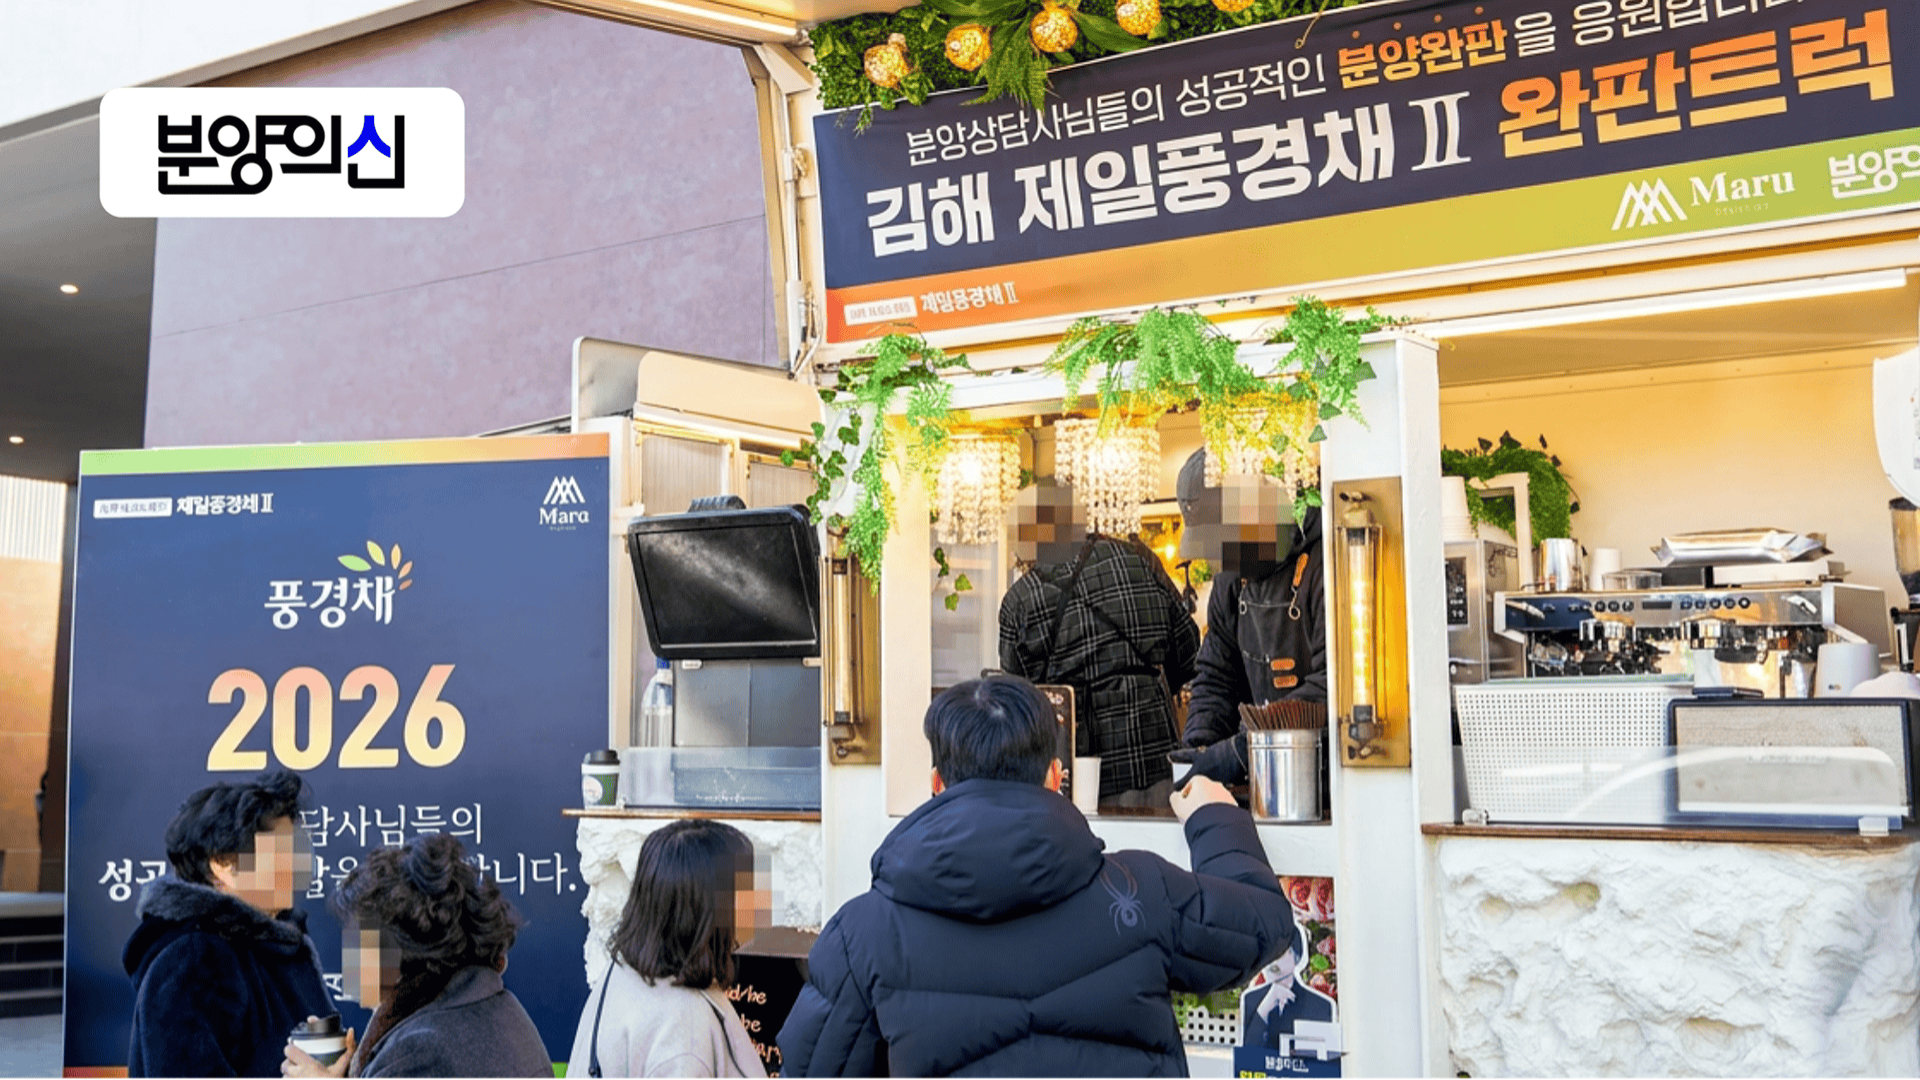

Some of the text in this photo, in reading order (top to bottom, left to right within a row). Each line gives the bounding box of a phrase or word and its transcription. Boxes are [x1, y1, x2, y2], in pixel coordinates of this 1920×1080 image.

[1176, 53, 1326, 117] 성공적인
[866, 172, 995, 258] 김해
[1014, 102, 1394, 234] 제일풍경채
[1499, 9, 1895, 158] 완판트럭
[1690, 171, 1796, 206] Maru
[264, 576, 396, 630] 풍경채
[207, 664, 466, 771] 2026
